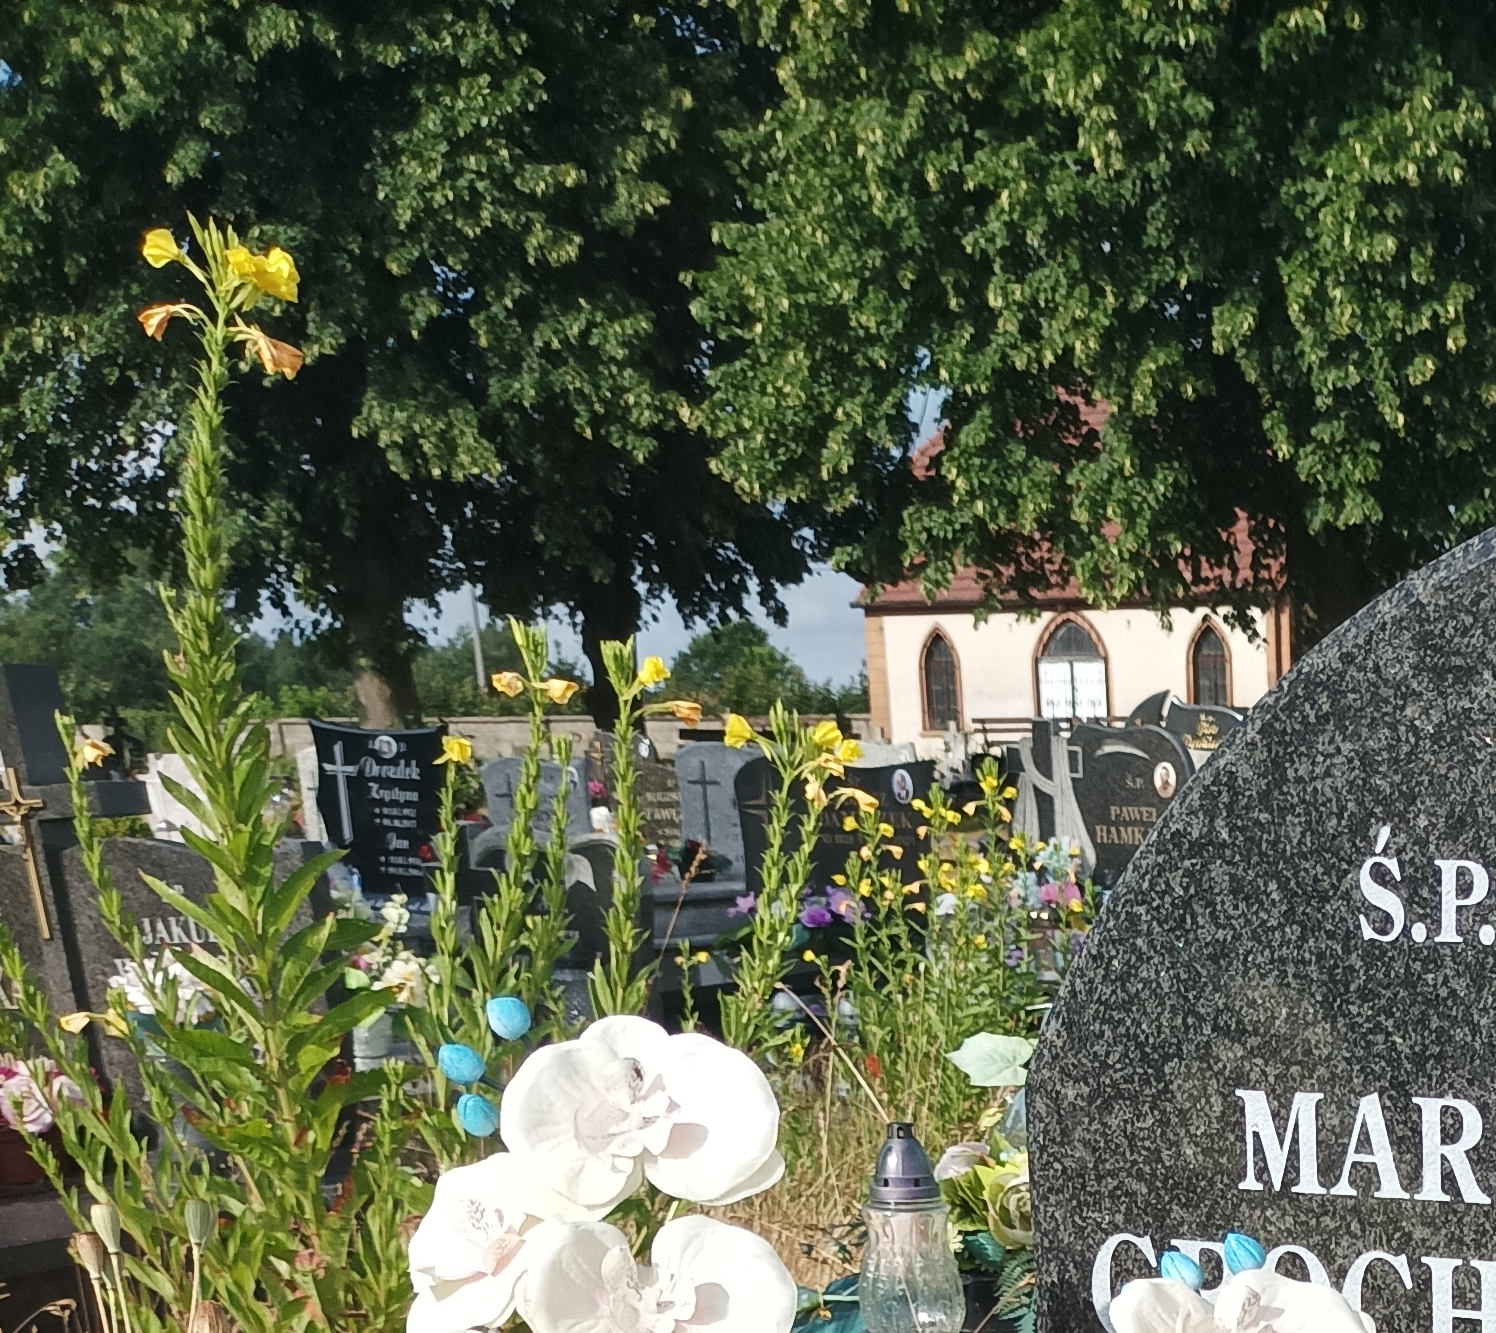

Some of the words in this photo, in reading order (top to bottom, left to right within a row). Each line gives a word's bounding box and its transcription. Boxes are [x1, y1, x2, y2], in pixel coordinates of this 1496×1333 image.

[1095, 825, 1152, 845] HAMK
[1359, 825, 1496, 945] Ś.P.
[140, 915, 219, 945] JAKU
